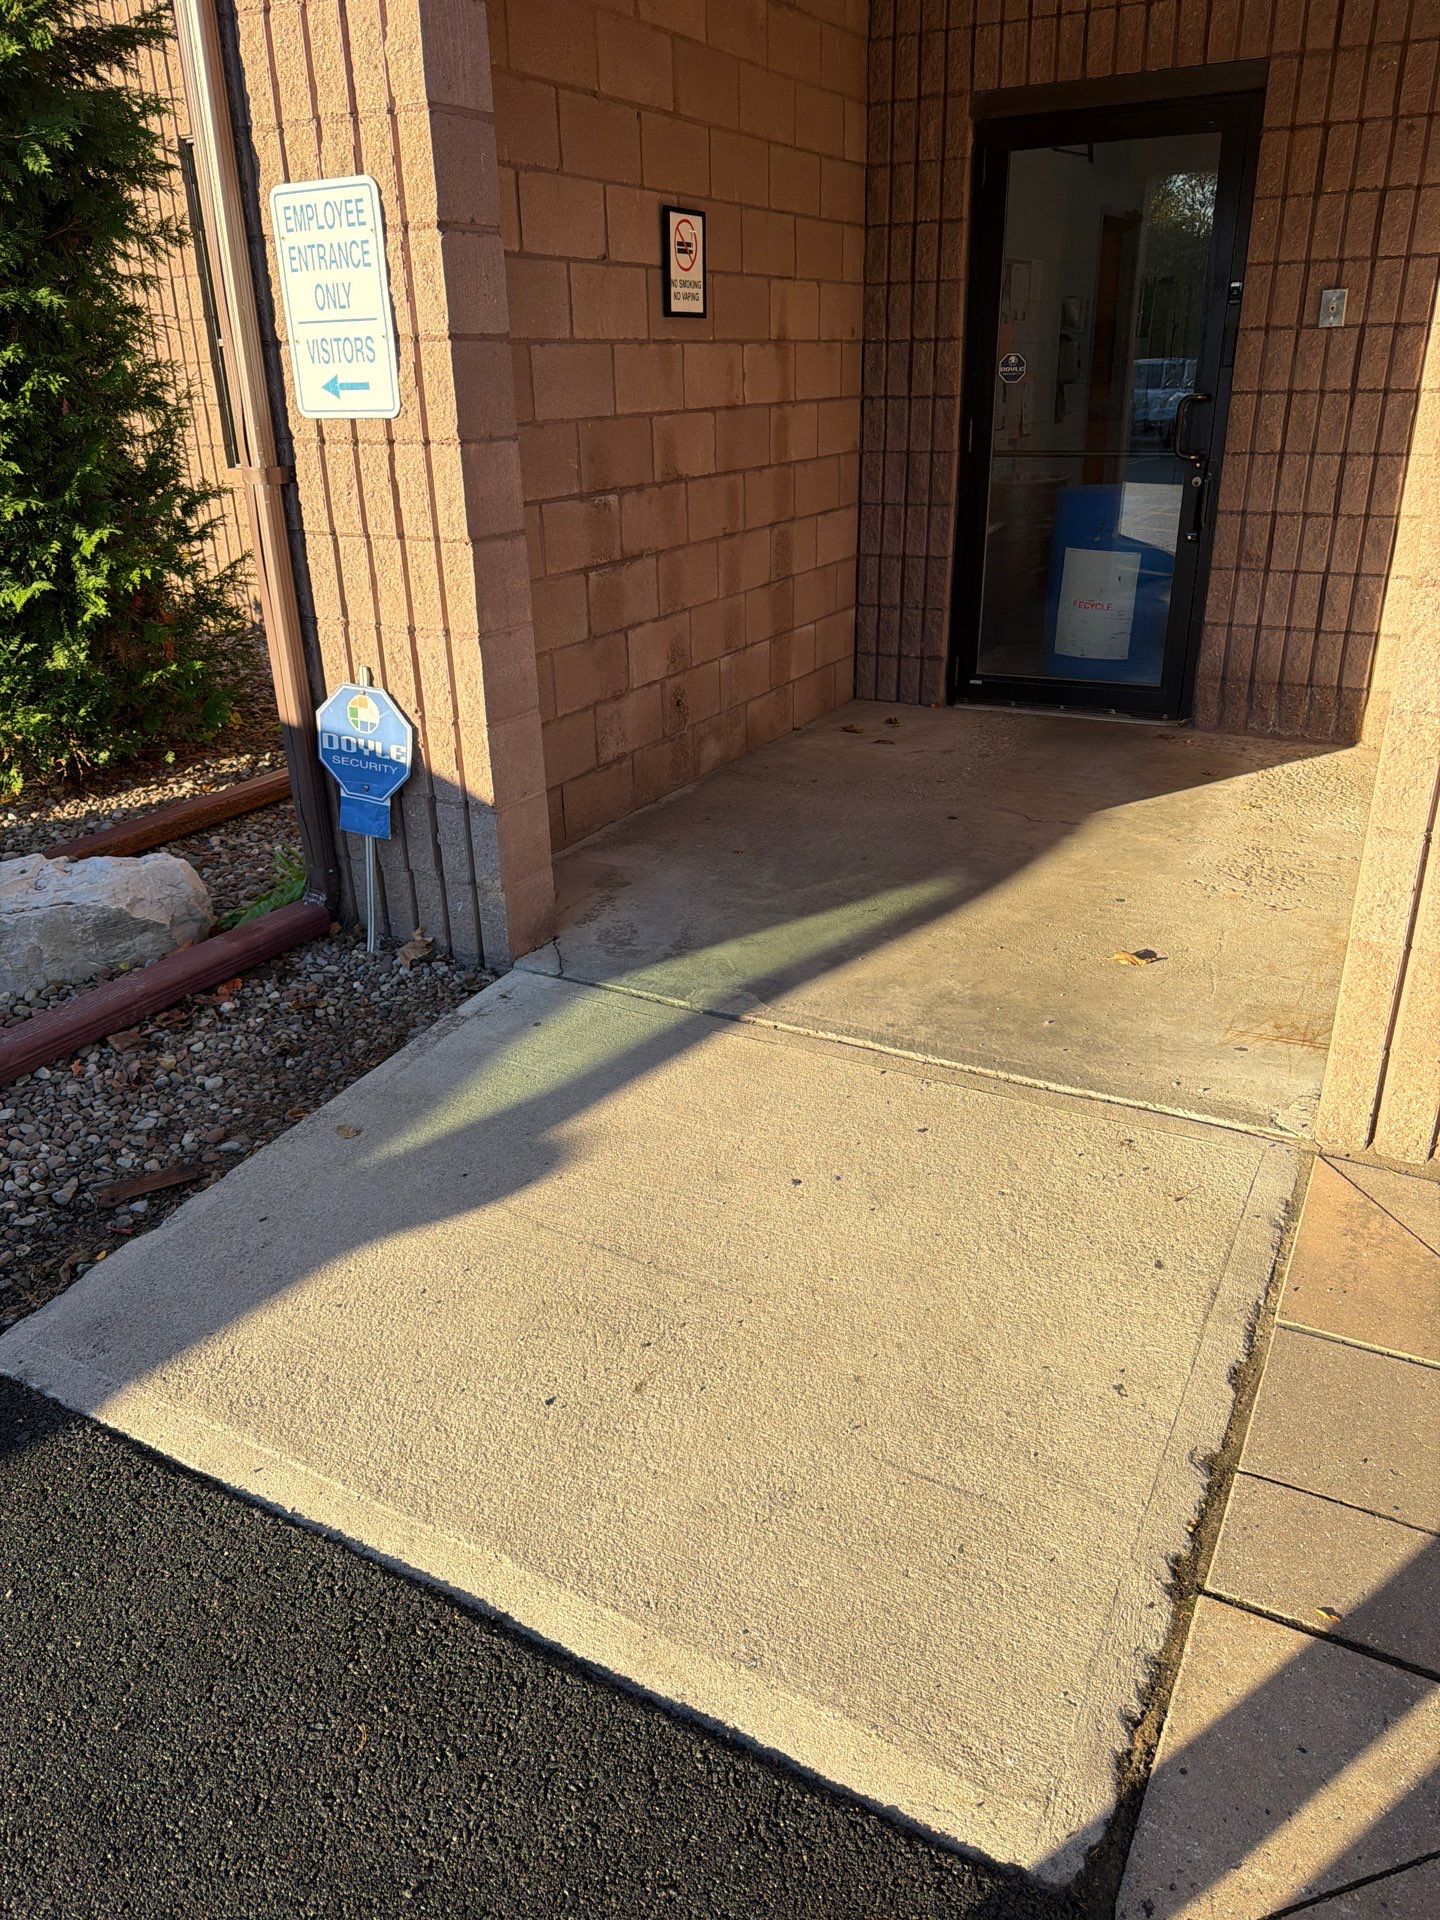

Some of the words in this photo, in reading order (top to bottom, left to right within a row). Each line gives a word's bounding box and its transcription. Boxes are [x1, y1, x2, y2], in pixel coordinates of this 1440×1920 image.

[283, 198, 366, 233] EMPLOYEE
[288, 239, 372, 273] ENTRANCE
[314, 282, 352, 311] ONLY
[672, 279, 678, 288] NO
[679, 279, 701, 289] SMOKING
[673, 291, 681, 301] NO
[682, 292, 700, 301] VAPING
[306, 336, 376, 365] VISITORS
[322, 732, 407, 764] DOYLE
[332, 755, 398, 775] SECURITY
